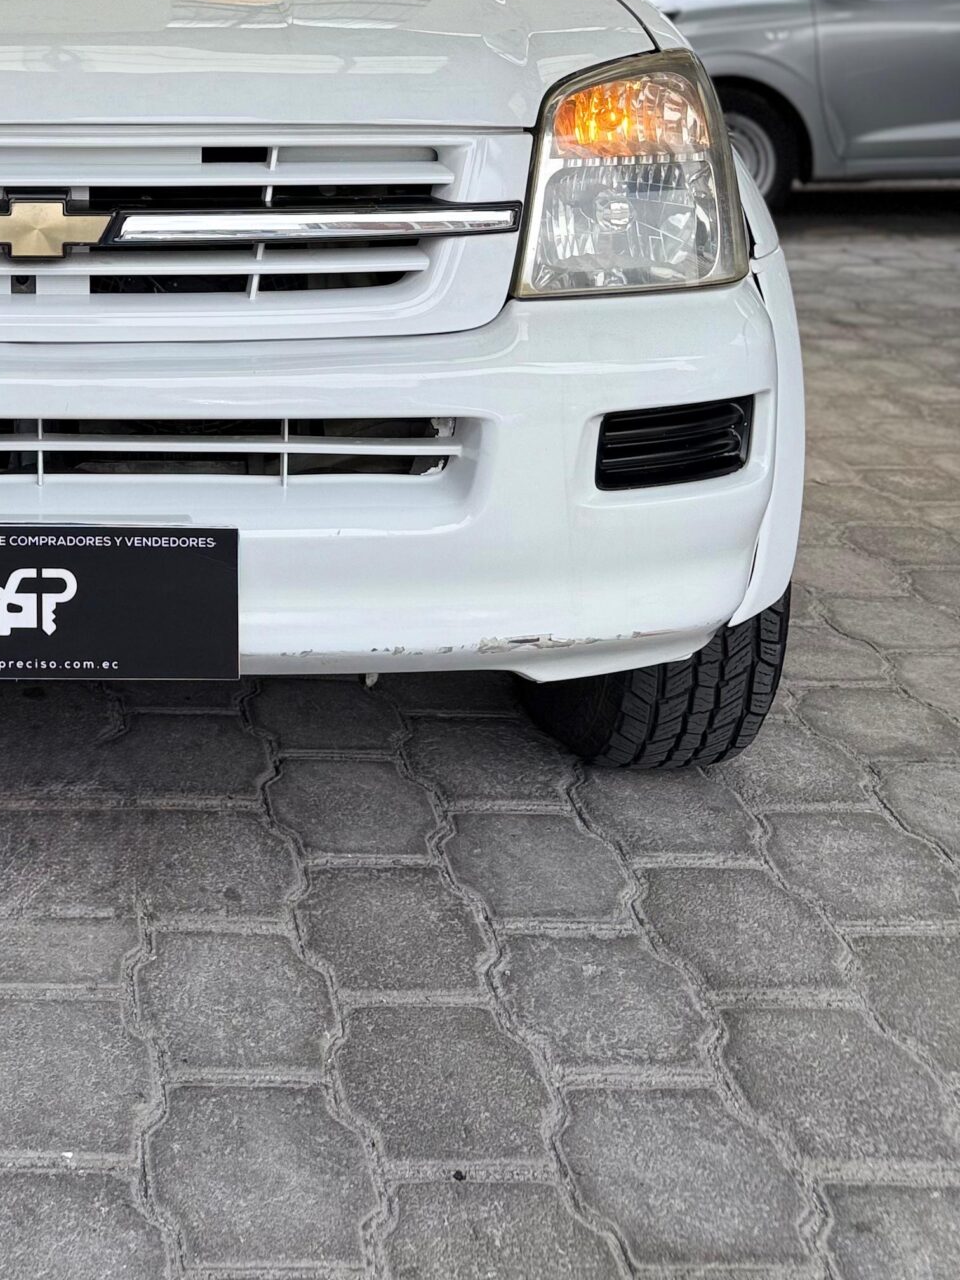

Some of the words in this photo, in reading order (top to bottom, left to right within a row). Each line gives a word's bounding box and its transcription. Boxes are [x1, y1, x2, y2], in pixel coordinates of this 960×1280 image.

[9, 535, 112, 547] COMPRADORES
[114, 536, 123, 547] Y
[125, 536, 215, 548] VENDEDORES
